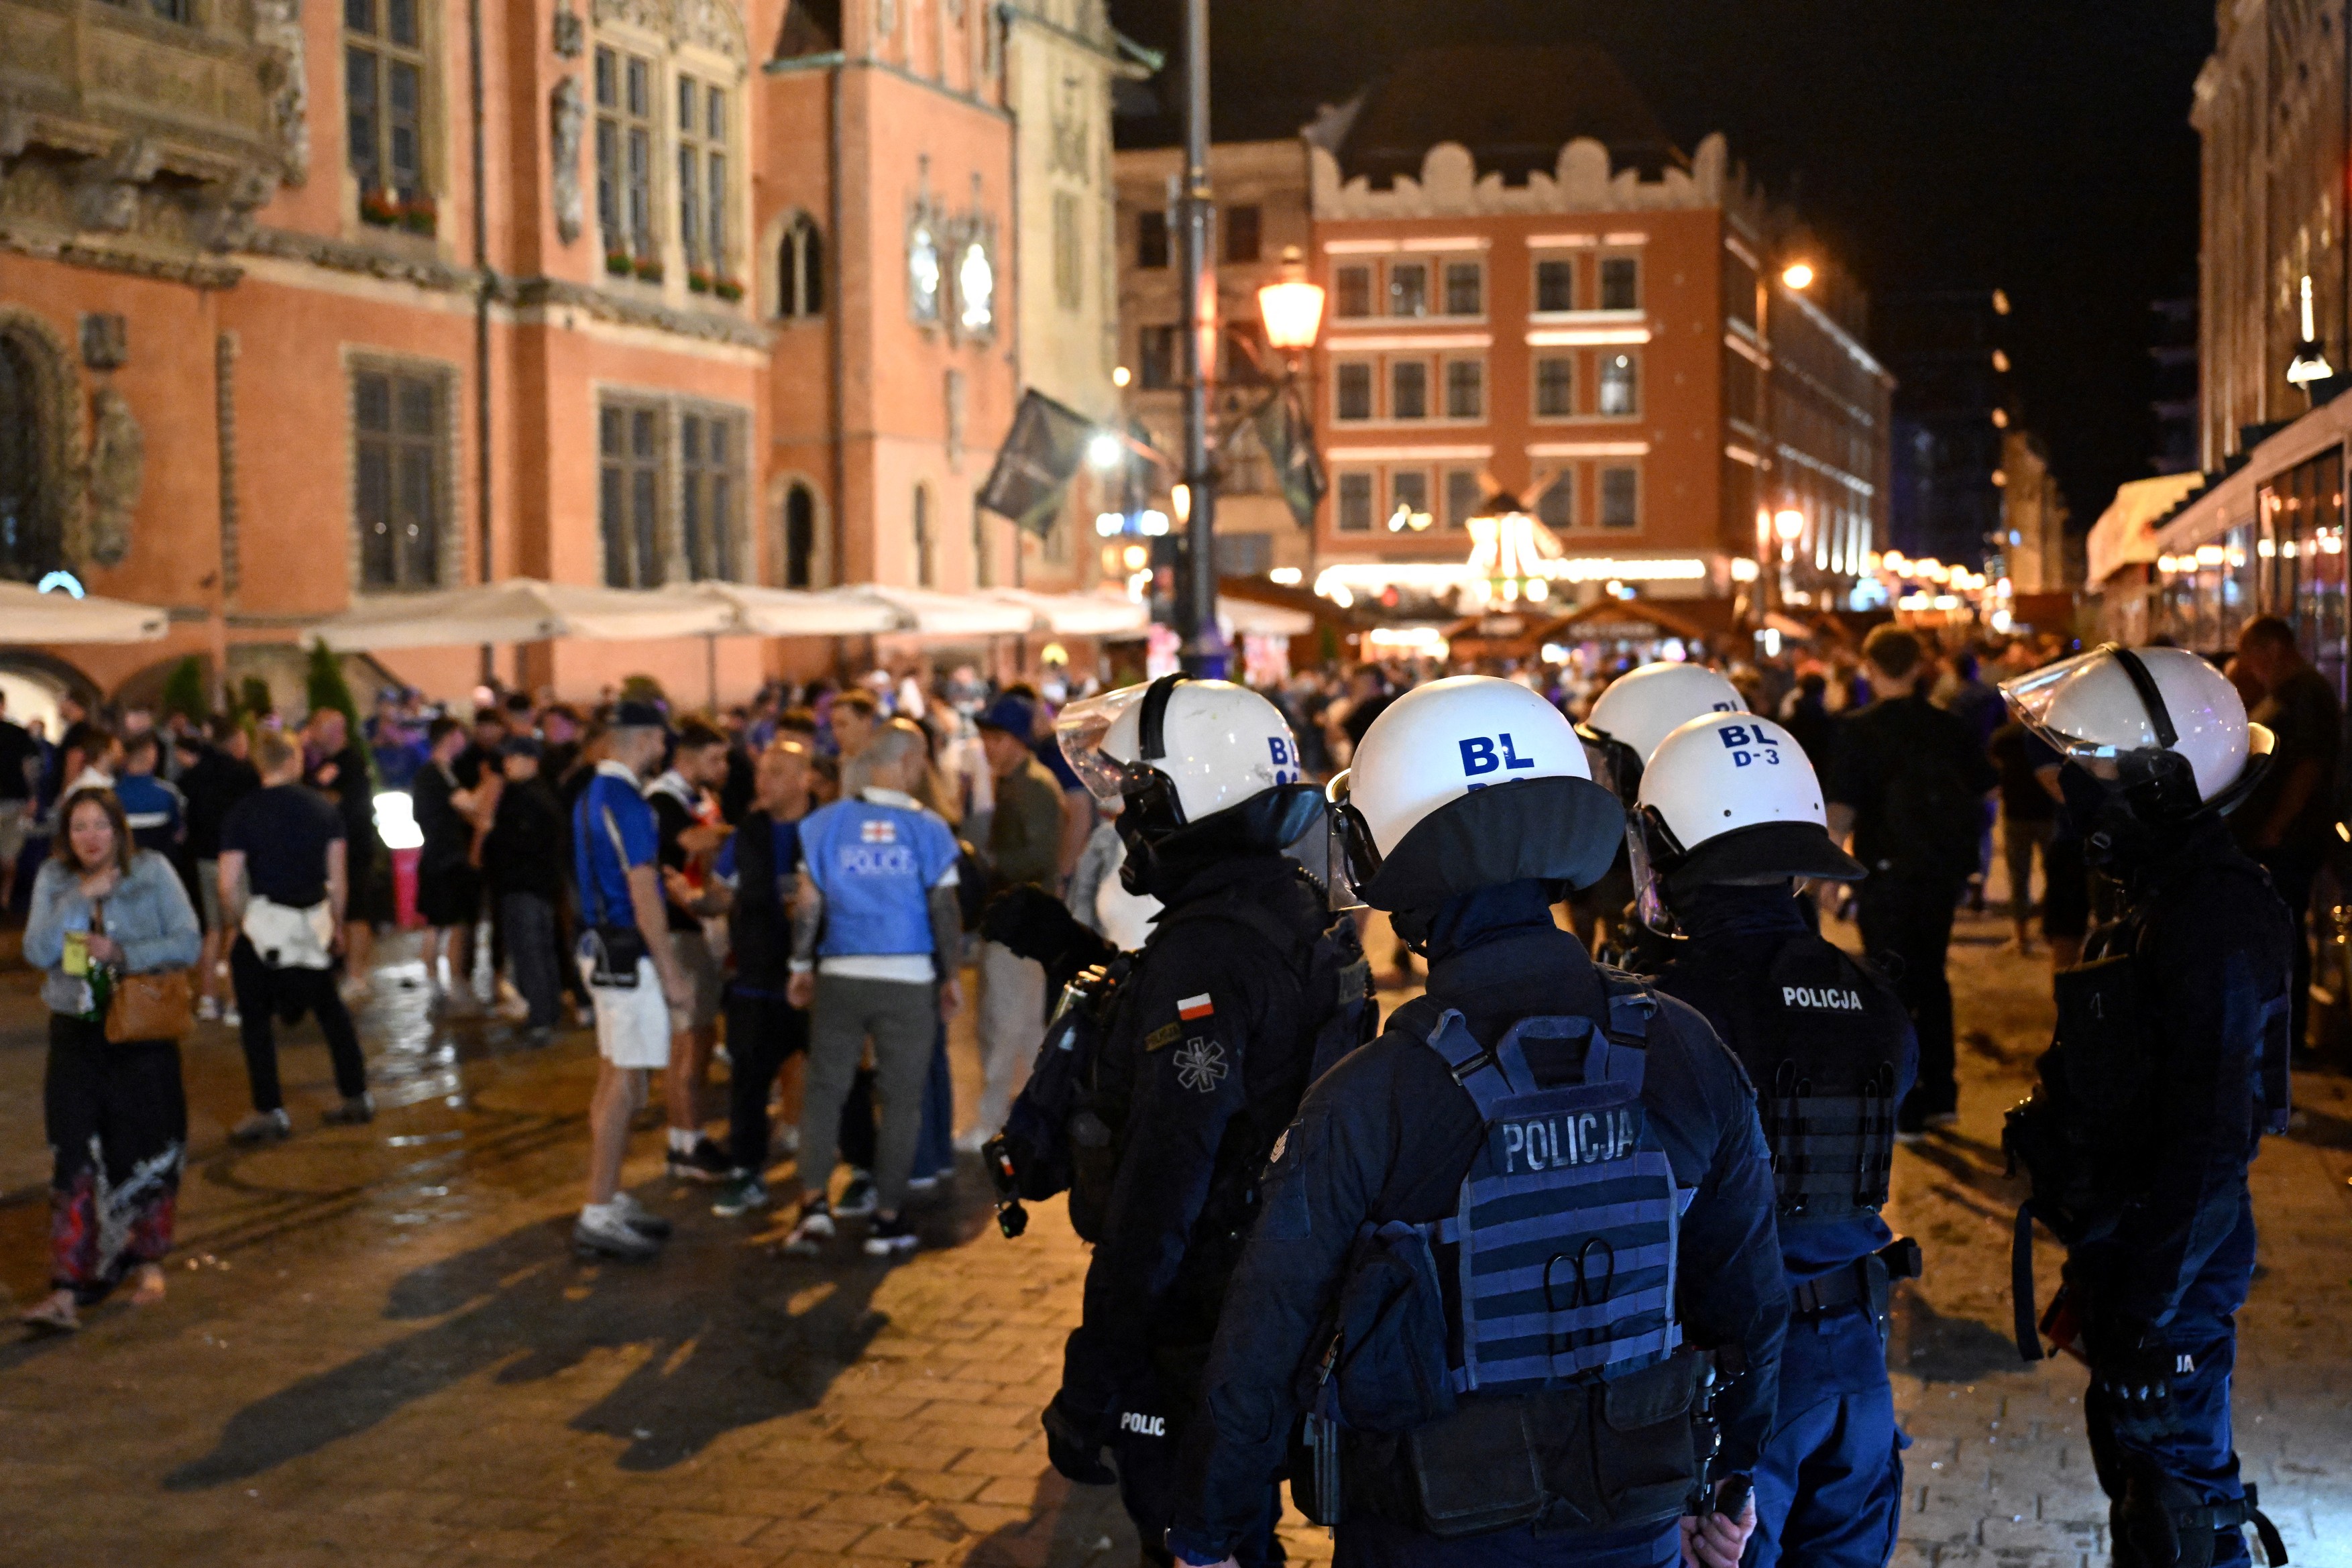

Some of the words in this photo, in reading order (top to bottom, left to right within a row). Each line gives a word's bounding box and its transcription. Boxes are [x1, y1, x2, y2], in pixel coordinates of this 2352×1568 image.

[1718, 724, 1779, 748] BL
[1458, 733, 1534, 777] BL
[1732, 749, 1779, 767] D-3
[1783, 987, 1862, 1009] POLICJA
[1503, 1108, 1634, 1173] POLICJA
